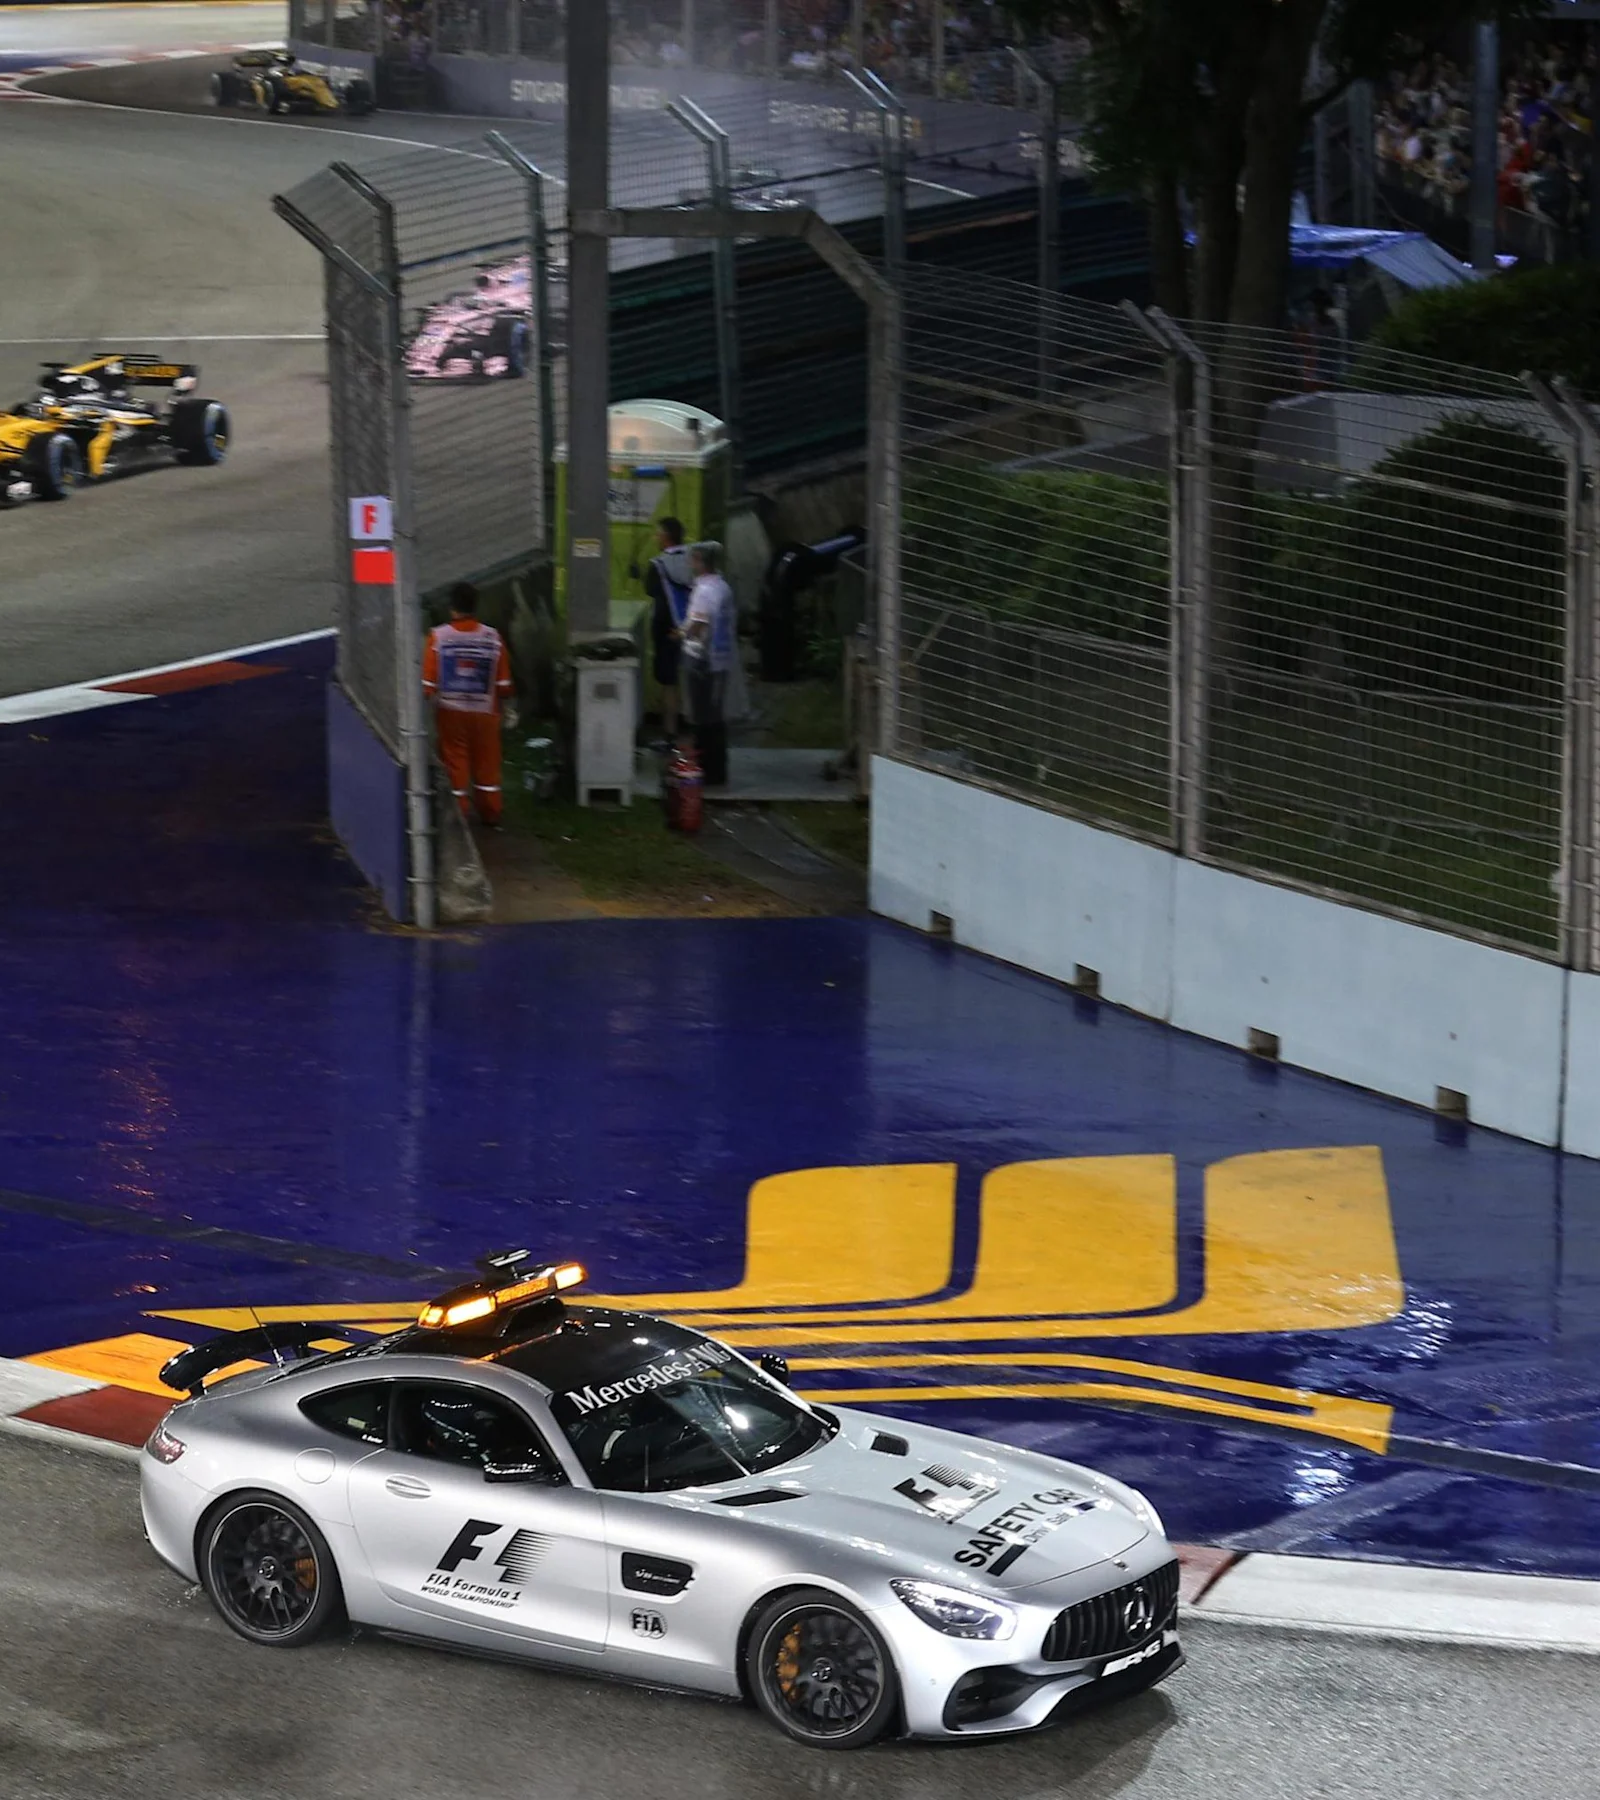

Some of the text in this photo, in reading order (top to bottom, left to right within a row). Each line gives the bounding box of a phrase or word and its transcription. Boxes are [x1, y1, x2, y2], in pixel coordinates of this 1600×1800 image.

[362, 503, 378, 535] F
[564, 1341, 731, 1415] Mercedes-AMG
[954, 1502, 1046, 1567] SAFETY
[1033, 1488, 1088, 1505] CAR
[435, 1518, 558, 1586] F1
[420, 1585, 515, 1609] WORLD CHAMPIONSHIP
[425, 1573, 522, 1601] FIA Formula 1
[632, 1613, 663, 1634] FIA
